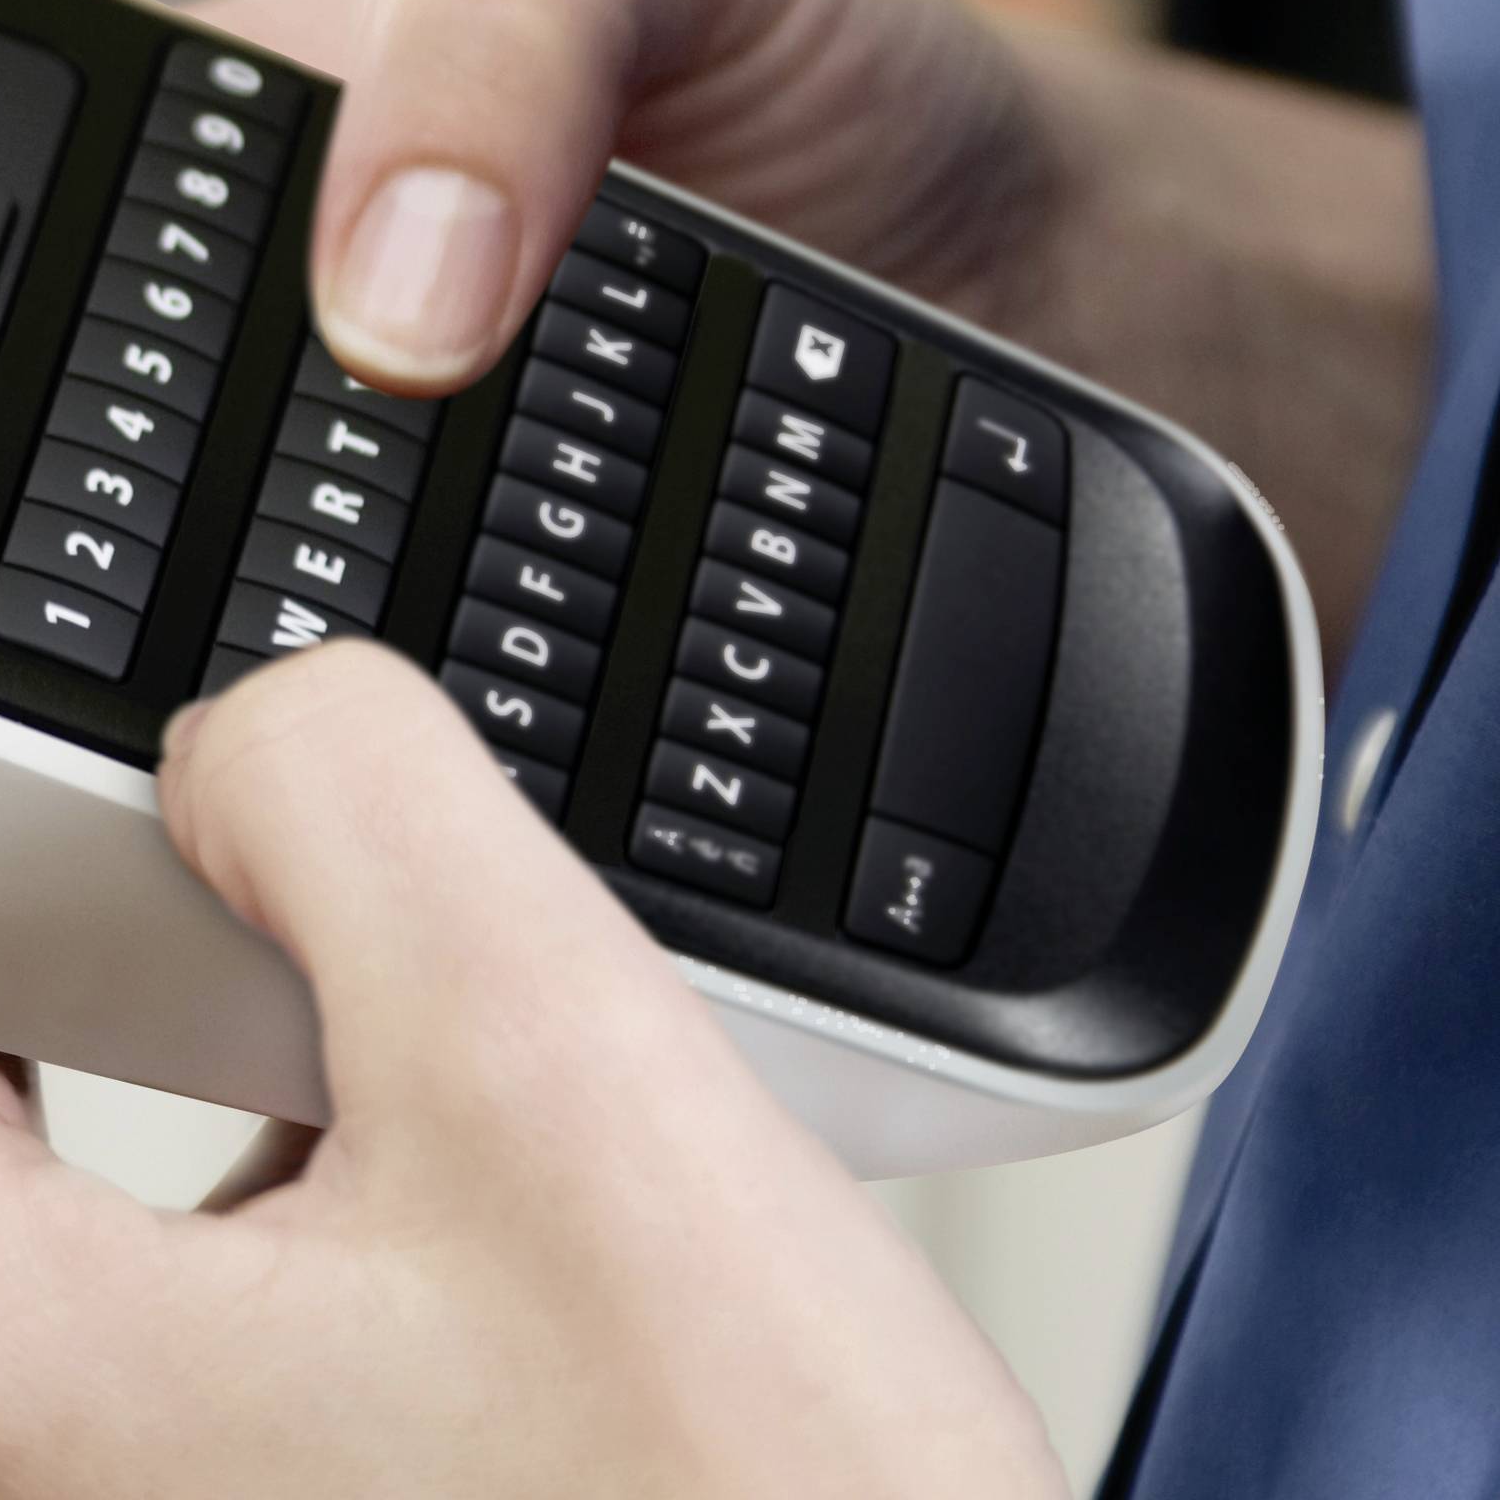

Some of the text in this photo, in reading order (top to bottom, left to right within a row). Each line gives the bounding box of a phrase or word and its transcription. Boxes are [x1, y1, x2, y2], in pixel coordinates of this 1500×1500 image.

[601, 285, 648, 309] L
[44, 58, 262, 629] 1 2 3 4 5 6 7 8 9 0
[585, 328, 633, 366] K
[571, 390, 615, 423] J
[327, 420, 380, 457] T
[776, 413, 825, 460] M
[552, 442, 602, 483] H
[311, 483, 365, 524] R
[764, 469, 812, 511] N
[538, 501, 586, 539] G
[294, 544, 346, 584] E
[750, 528, 797, 565] B
[519, 565, 565, 602] F
[735, 580, 783, 617] V
[271, 598, 328, 648] W
[501, 626, 549, 667] D
[722, 643, 770, 681] C
[485, 689, 533, 727] S
[706, 703, 756, 745] X
[692, 763, 742, 806] Z
